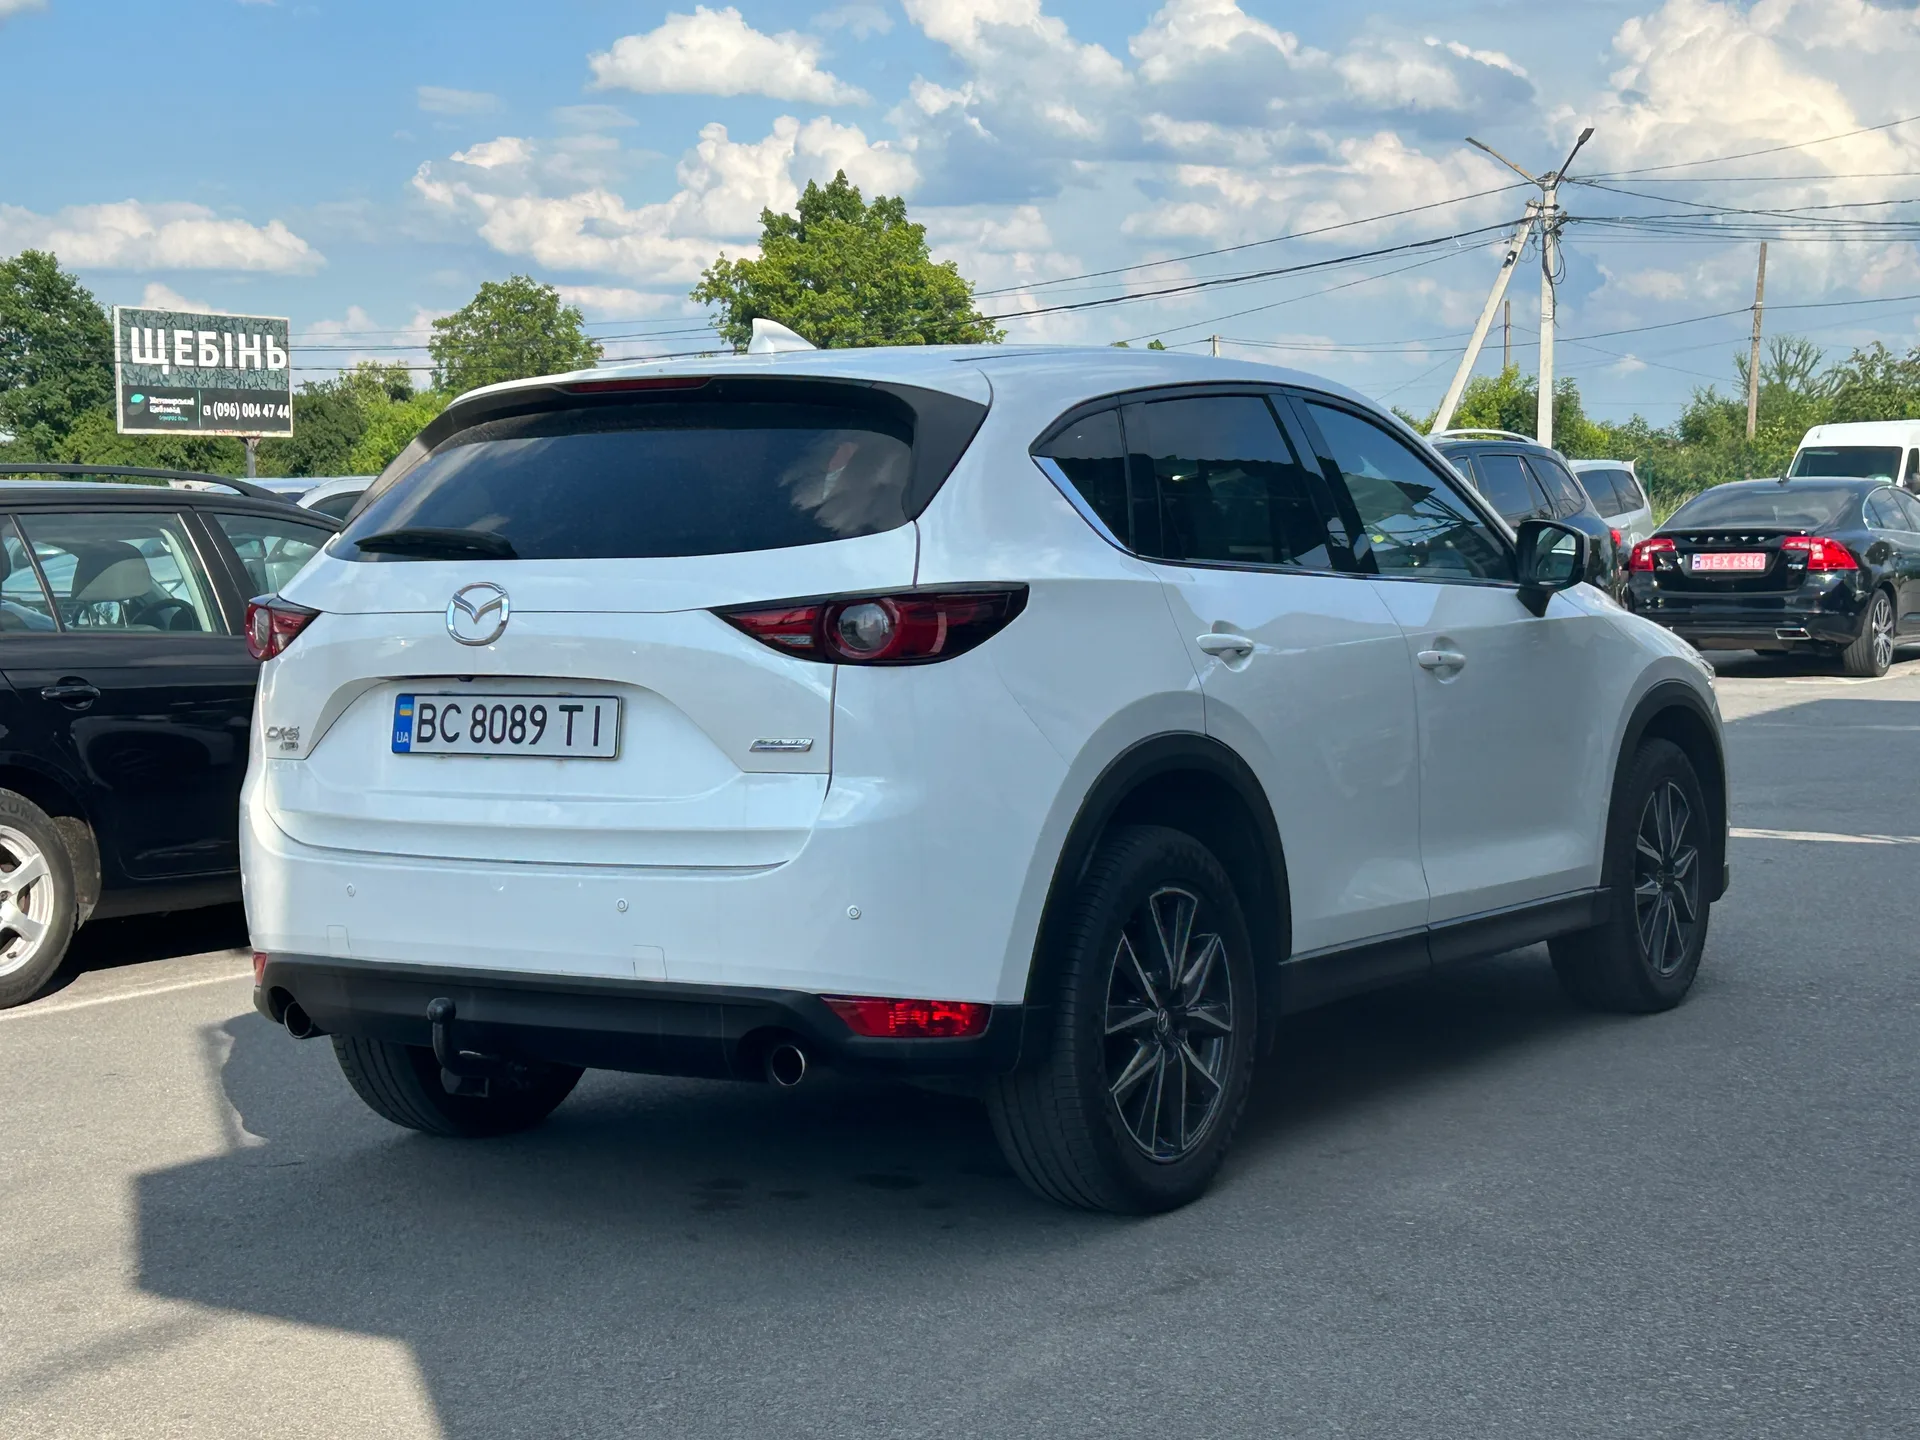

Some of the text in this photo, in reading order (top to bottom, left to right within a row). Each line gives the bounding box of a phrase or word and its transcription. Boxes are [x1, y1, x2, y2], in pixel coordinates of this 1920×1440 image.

[130, 327, 288, 375] ЩЕБІНЬ
[213, 401, 240, 420] (096)
[242, 402, 261, 418] 004
[262, 403, 275, 418] 47
[277, 404, 290, 419] 44
[396, 731, 410, 744] UA
[416, 703, 601, 747] BC 8089 TI
